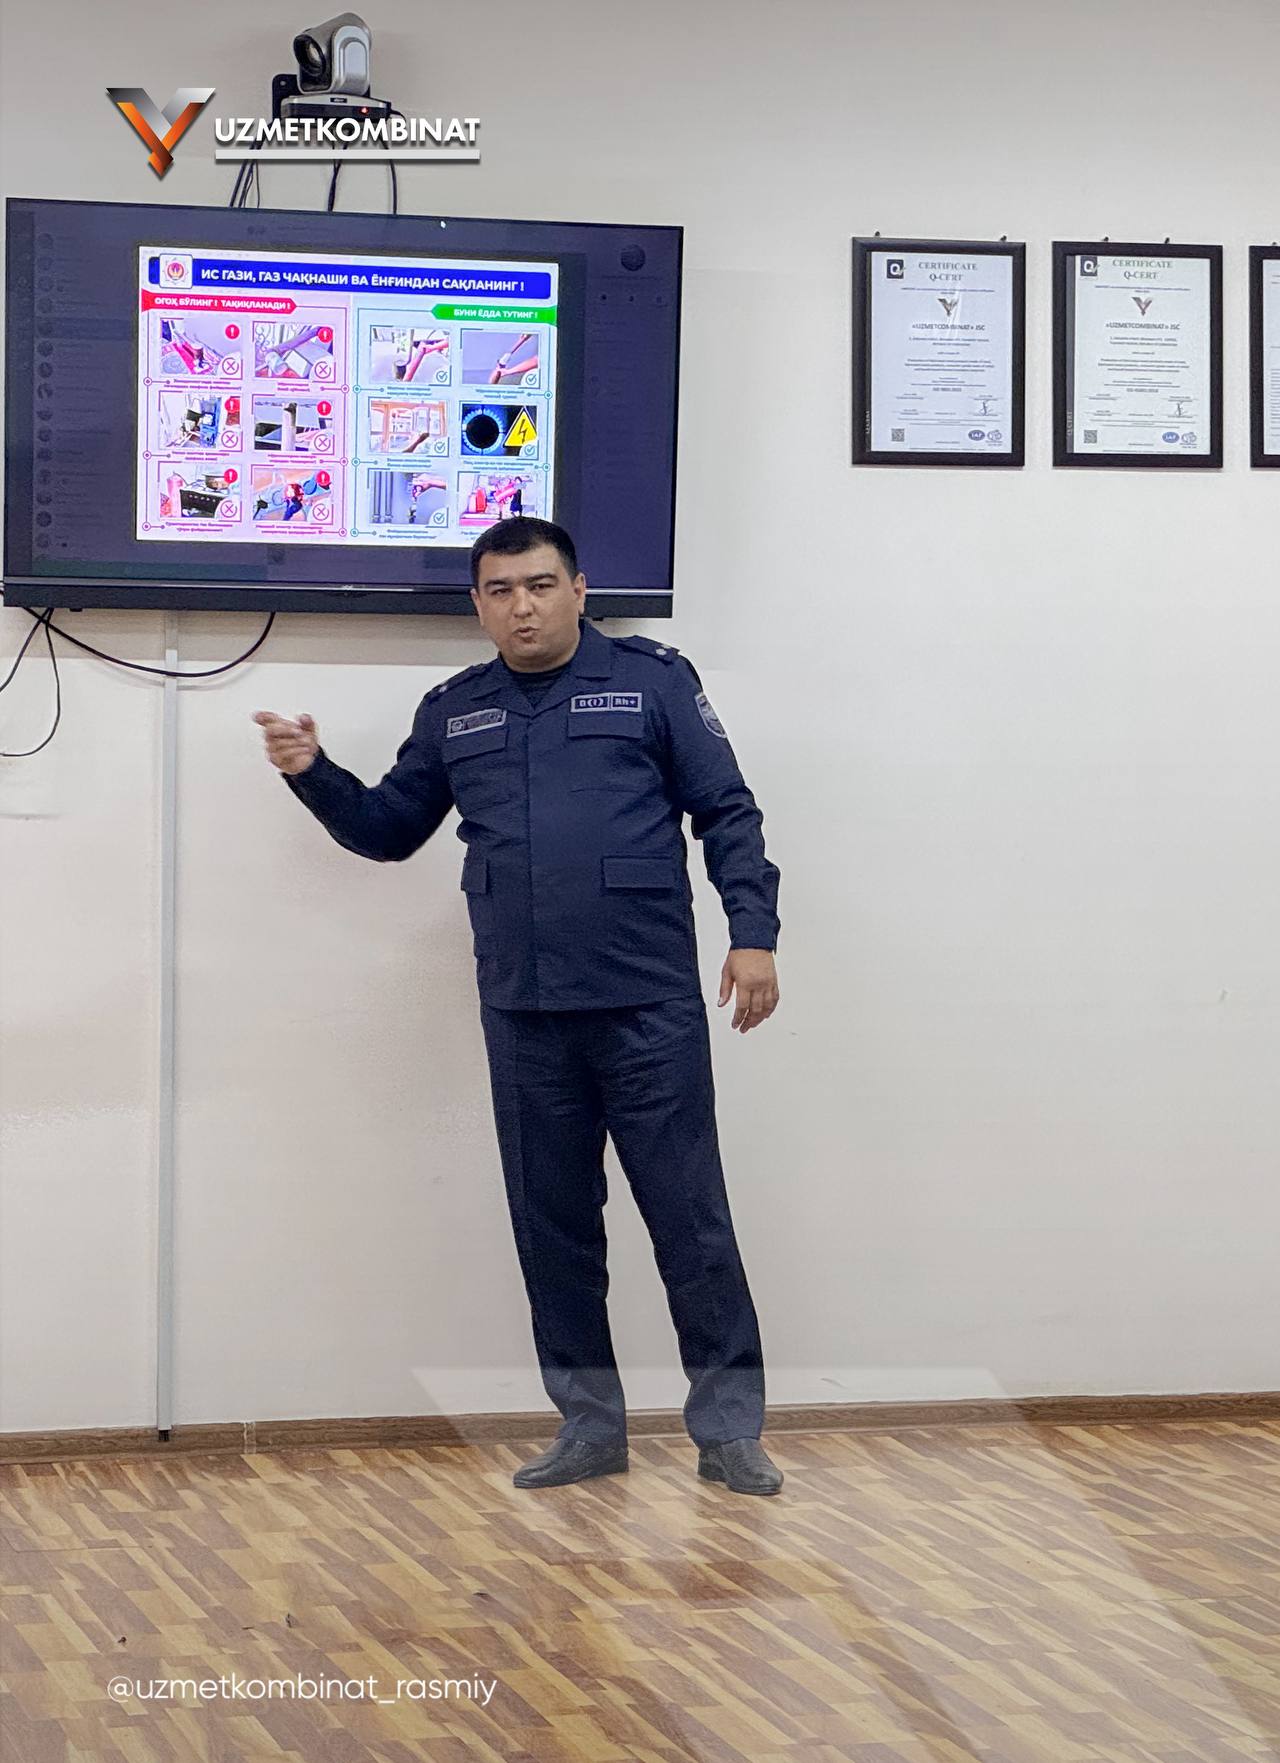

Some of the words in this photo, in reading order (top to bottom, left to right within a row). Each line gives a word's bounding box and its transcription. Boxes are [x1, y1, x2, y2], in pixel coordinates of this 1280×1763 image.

[918, 261, 978, 271] CERTIFICATE
[1112, 259, 1174, 269] CERTIFICATE
[201, 268, 219, 281] ИС
[222, 269, 256, 283] ГАЗИ,
[258, 271, 281, 283] ГАЗ
[282, 272, 348, 286] ЧАҚНАШИ
[351, 275, 369, 286] ВА
[371, 274, 440, 290] ЁНҒИНДАН
[441, 278, 519, 292] САҚЛАНИНГ
[929, 273, 963, 282] Q-CERT
[1123, 270, 1159, 281] Q-CERT
[154, 297, 178, 307] ОГОҲ
[179, 297, 213, 307] БЎЛИНГ
[220, 299, 286, 310] ТАҚИҚЛАНАДИ
[453, 308, 477, 317] БУНИ
[478, 308, 501, 318] ЁДДА
[502, 310, 533, 319] ТУТИНГ
